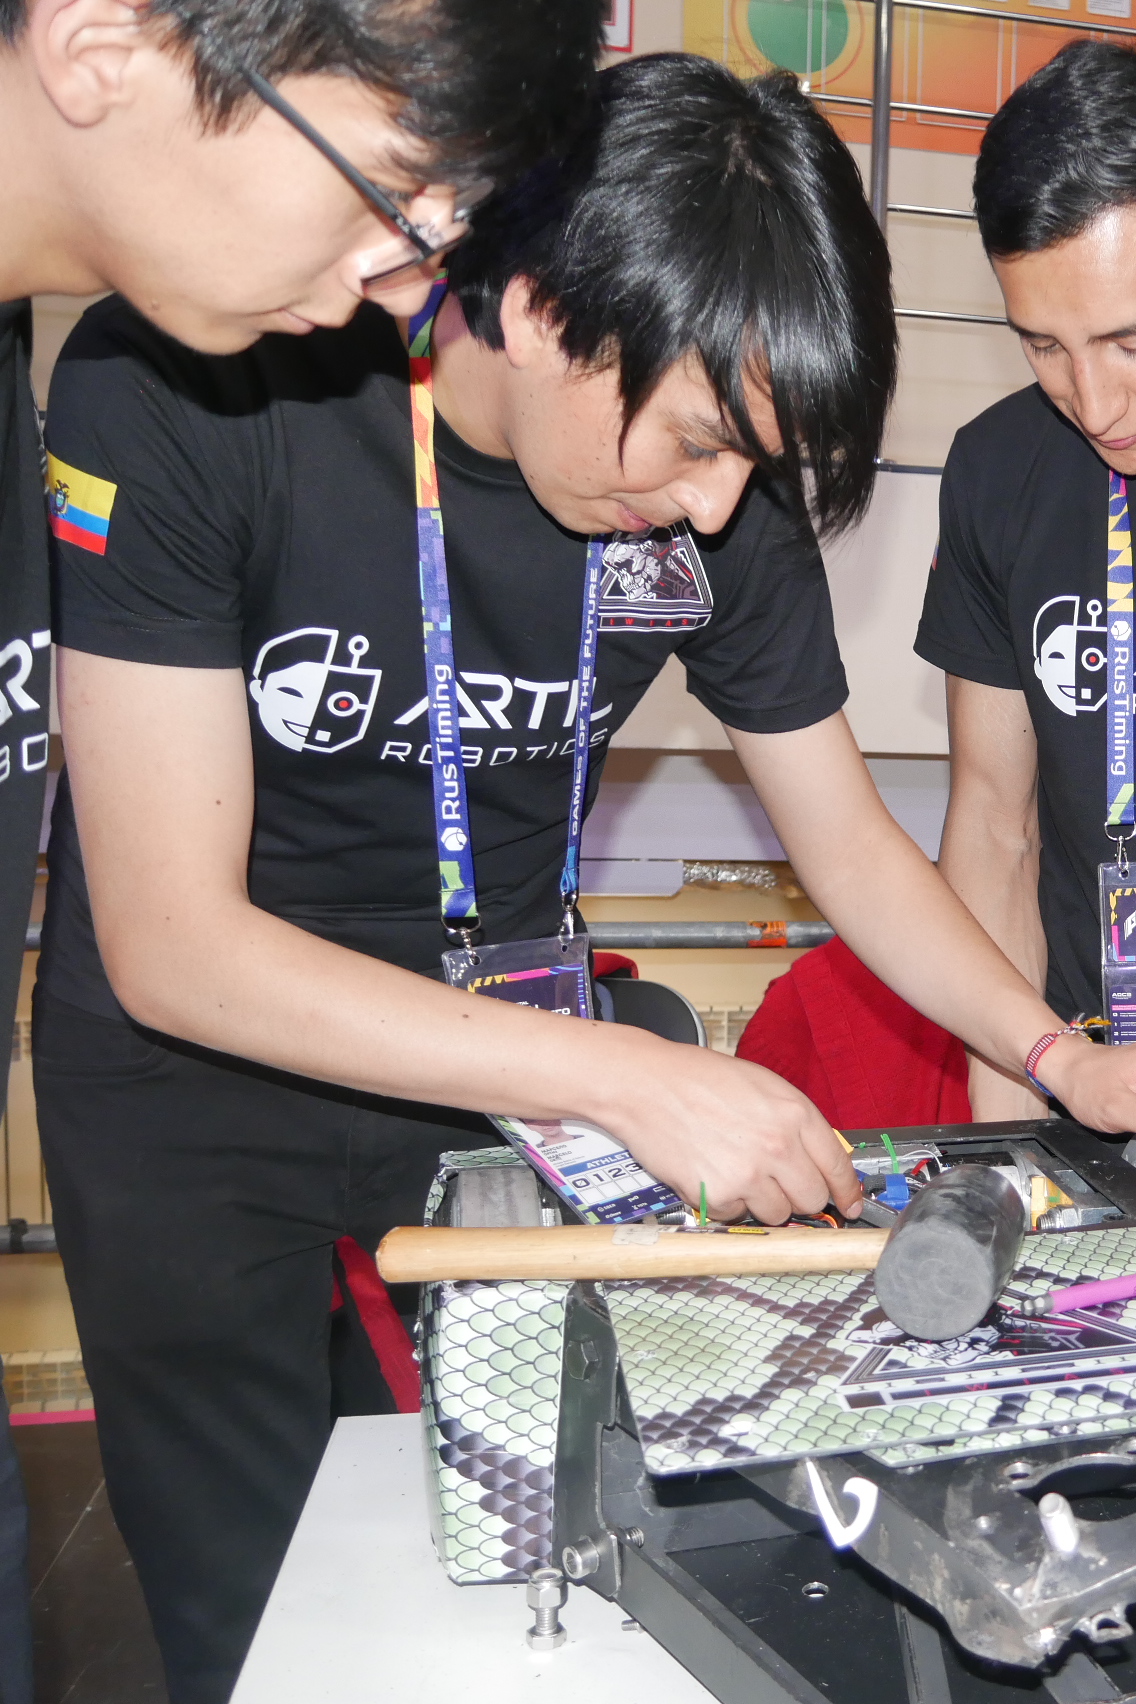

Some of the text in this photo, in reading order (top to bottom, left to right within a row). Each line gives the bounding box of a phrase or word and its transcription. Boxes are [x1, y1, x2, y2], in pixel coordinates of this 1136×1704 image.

[433, 664, 462, 820] RusTiming
[571, 568, 598, 836] GAMES OF THE FUTURE
[1109, 647, 1130, 776] RusTiming
[586, 1152, 630, 1169] ATHLET
